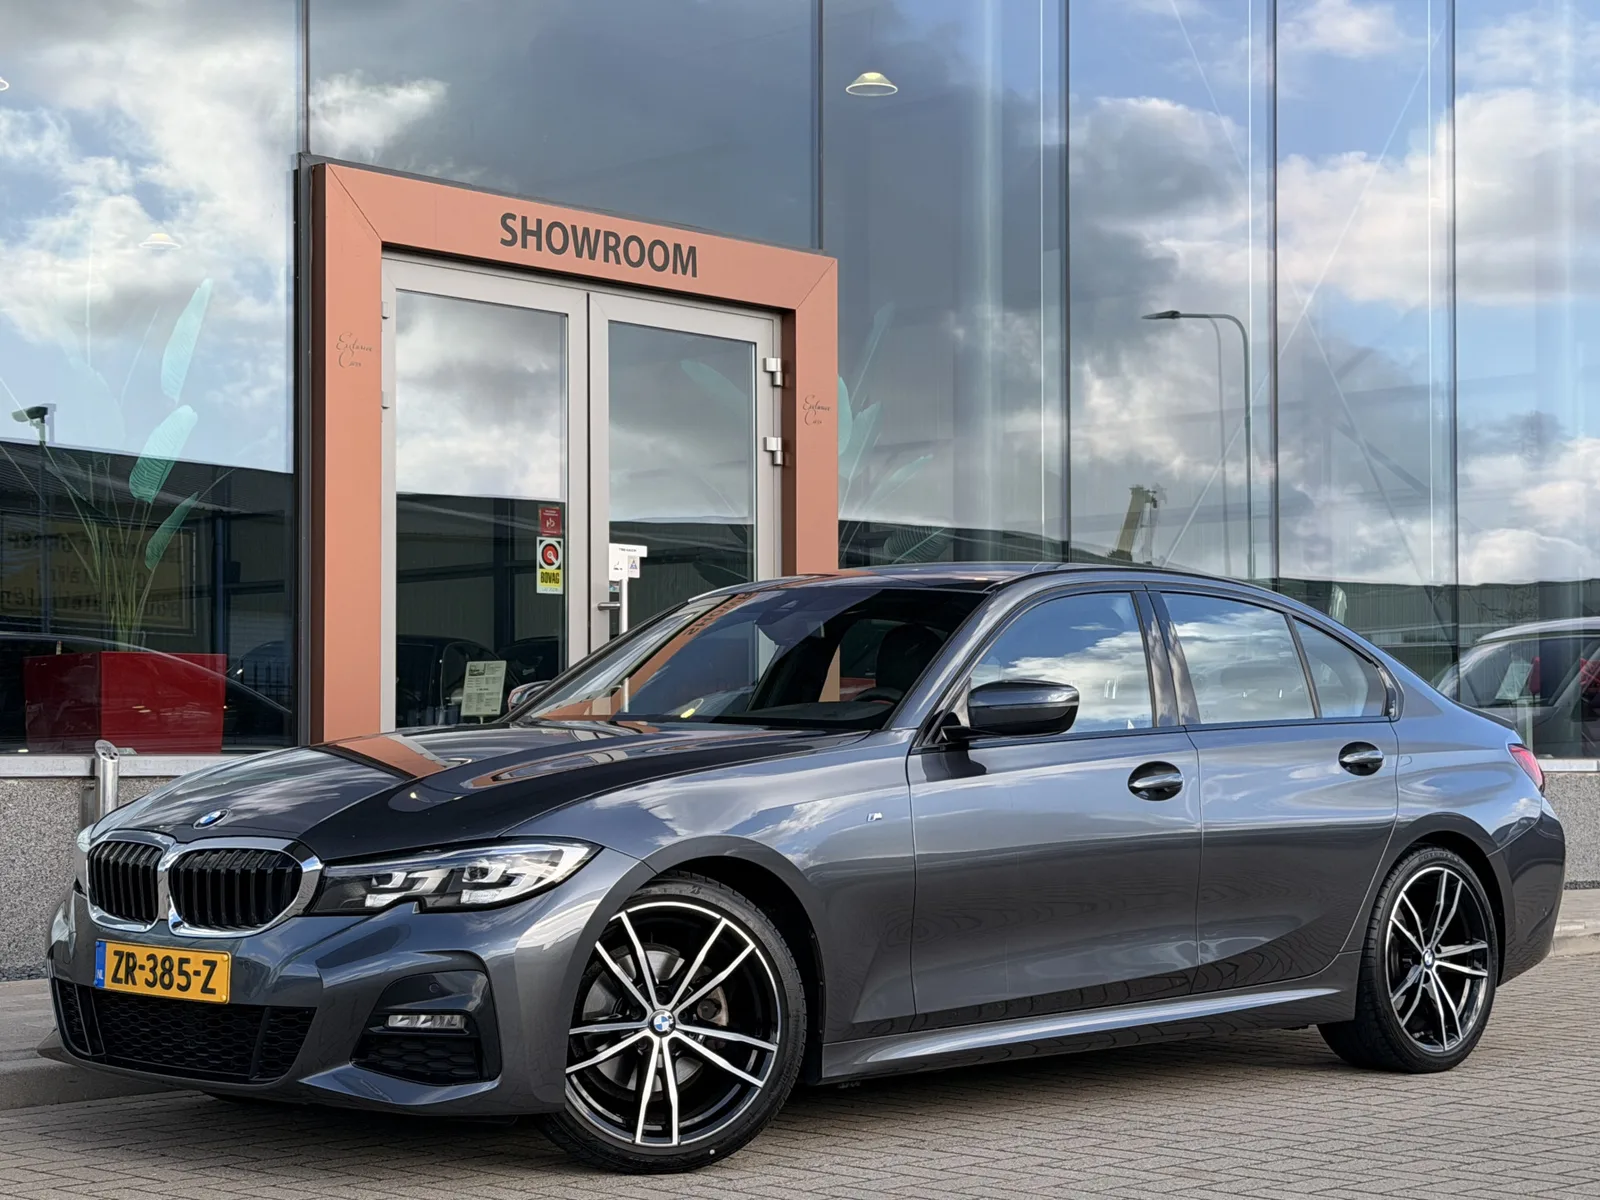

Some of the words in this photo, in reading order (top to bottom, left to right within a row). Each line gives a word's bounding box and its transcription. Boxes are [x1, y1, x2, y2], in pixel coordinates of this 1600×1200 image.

[500, 212, 698, 278] SHOWROOM
[540, 571, 560, 584] BOVAG
[96, 968, 104, 980] NL
[111, 950, 218, 995] ZR-385-Z
